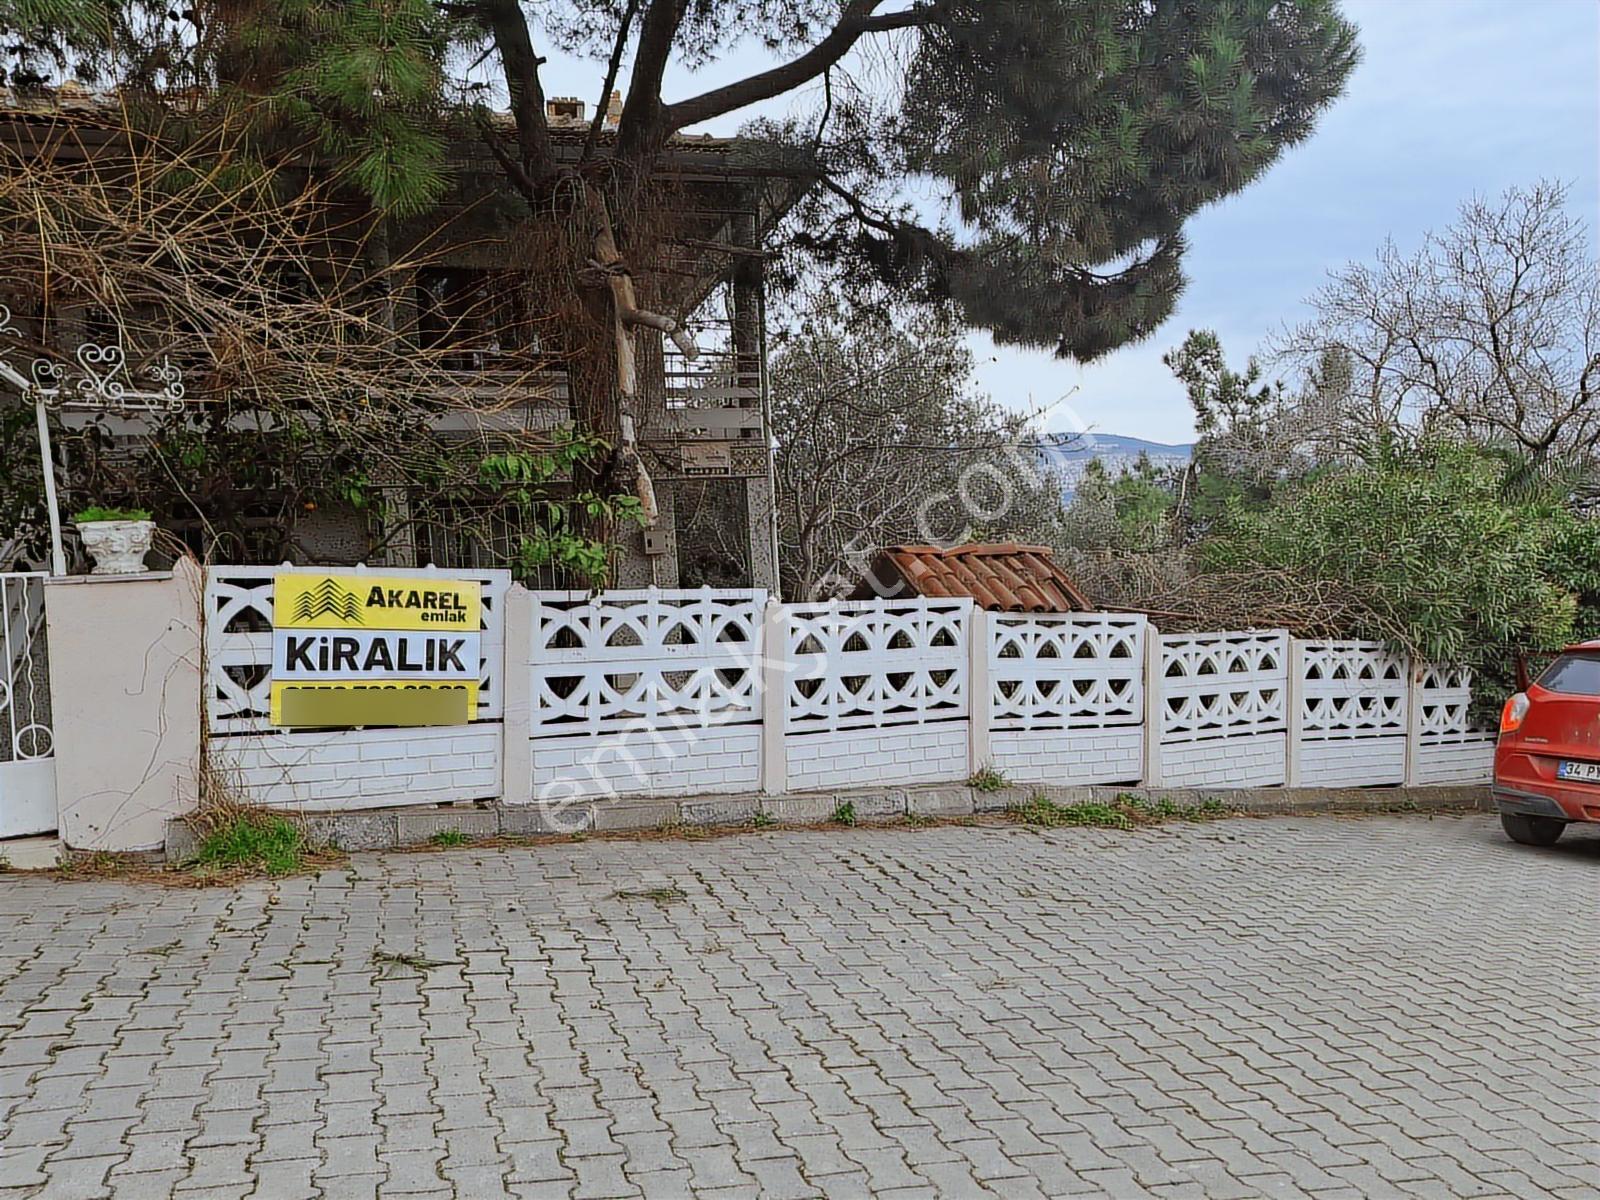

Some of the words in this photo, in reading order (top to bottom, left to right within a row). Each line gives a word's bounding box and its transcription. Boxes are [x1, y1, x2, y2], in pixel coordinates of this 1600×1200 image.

[366, 586, 467, 610] AKAREL
[421, 610, 466, 623] emlak
[285, 636, 466, 672] KiRALIK
[1566, 763, 1581, 776] 34
